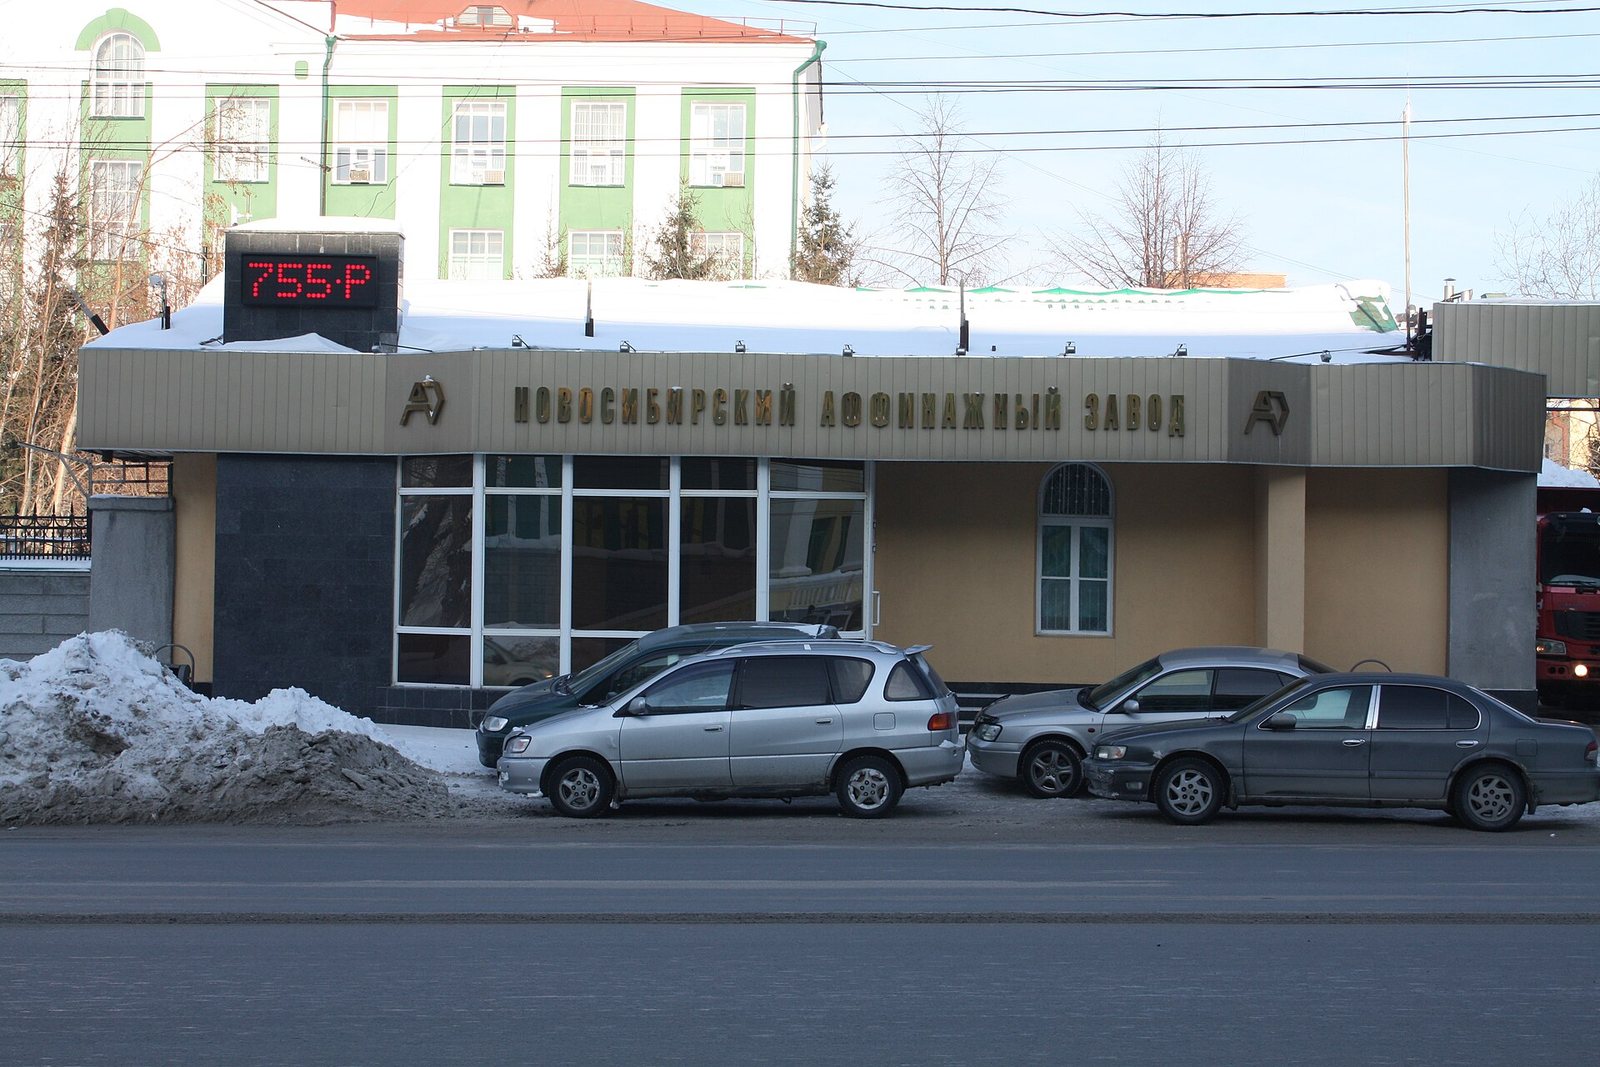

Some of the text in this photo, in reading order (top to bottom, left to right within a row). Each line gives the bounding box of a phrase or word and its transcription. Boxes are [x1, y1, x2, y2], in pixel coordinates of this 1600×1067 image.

[514, 382, 1185, 438] НОВОСИБИРСКИЙ АФФИНАЖНЫЙ ЗАВОД
